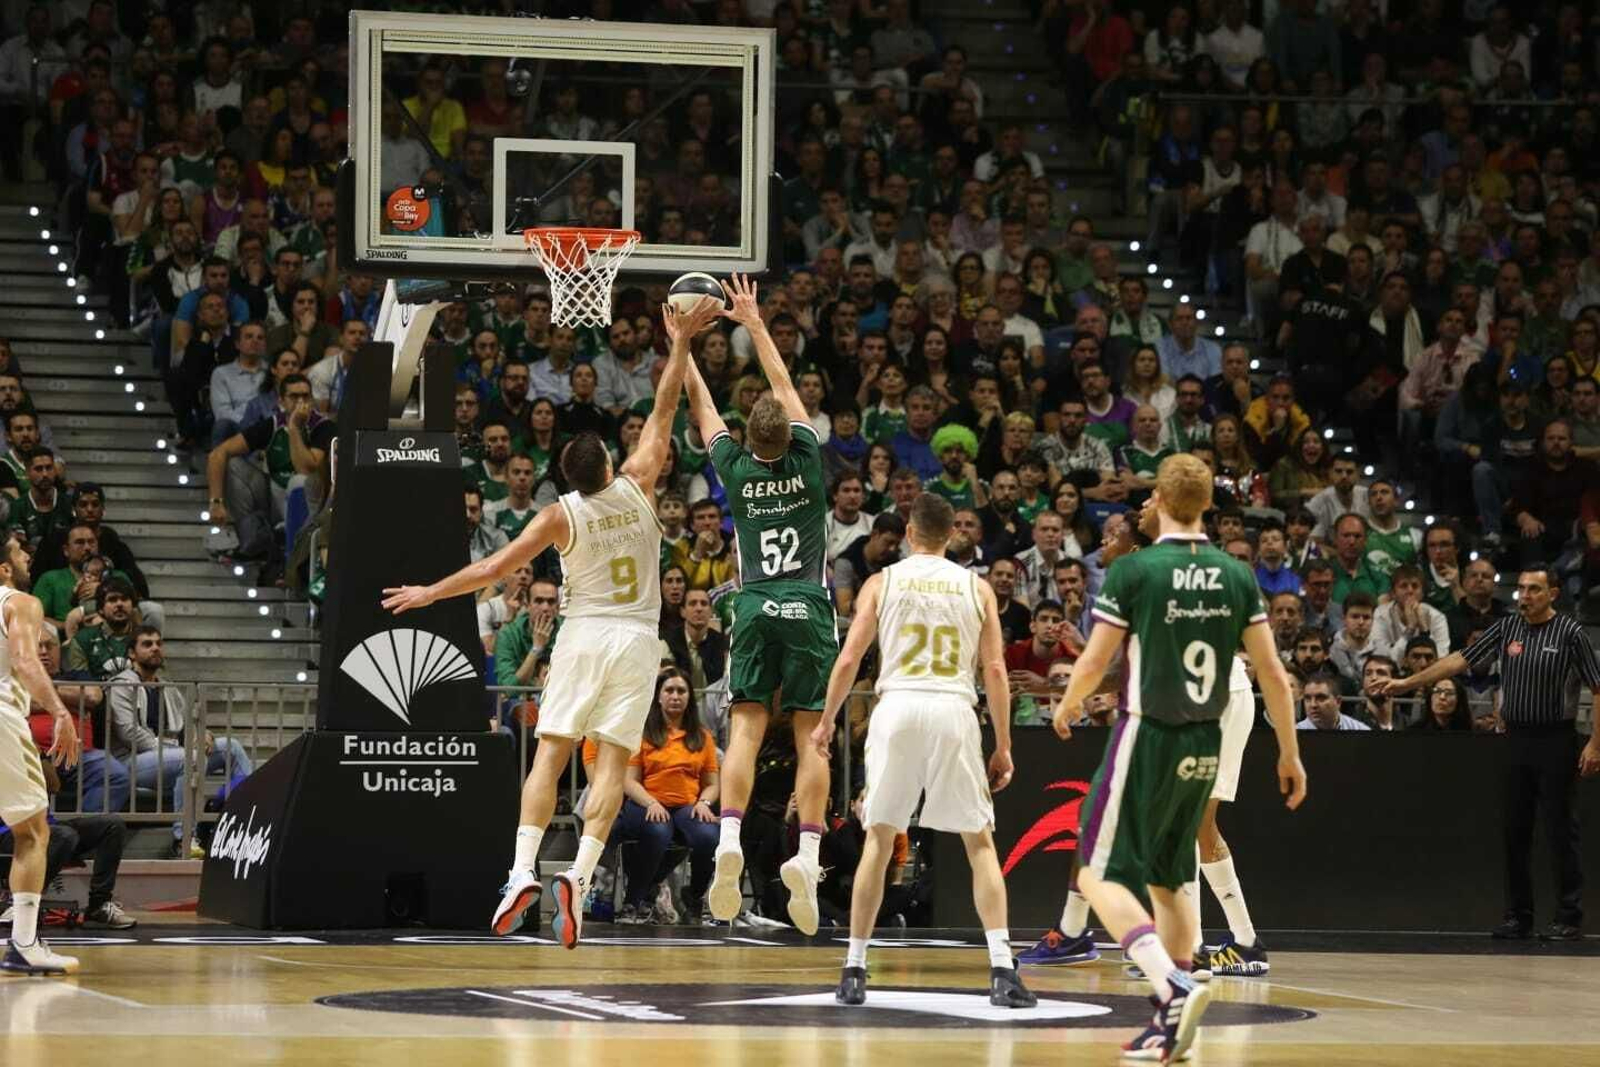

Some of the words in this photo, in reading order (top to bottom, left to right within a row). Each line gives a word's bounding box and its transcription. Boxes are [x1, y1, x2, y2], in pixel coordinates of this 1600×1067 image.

[365, 249, 408, 260] SPALDING
[1301, 301, 1350, 320] STAFF
[376, 447, 442, 463] SPALDING
[742, 474, 806, 498] GERUN
[760, 526, 802, 576] 52
[610, 556, 638, 603] 9
[897, 577, 964, 596] CARROLL
[1172, 563, 1224, 590] DÍAZ
[899, 624, 960, 677] 20
[1183, 640, 1217, 705] 9
[343, 735, 477, 756] Fundación
[362, 768, 457, 797] Unicaja
